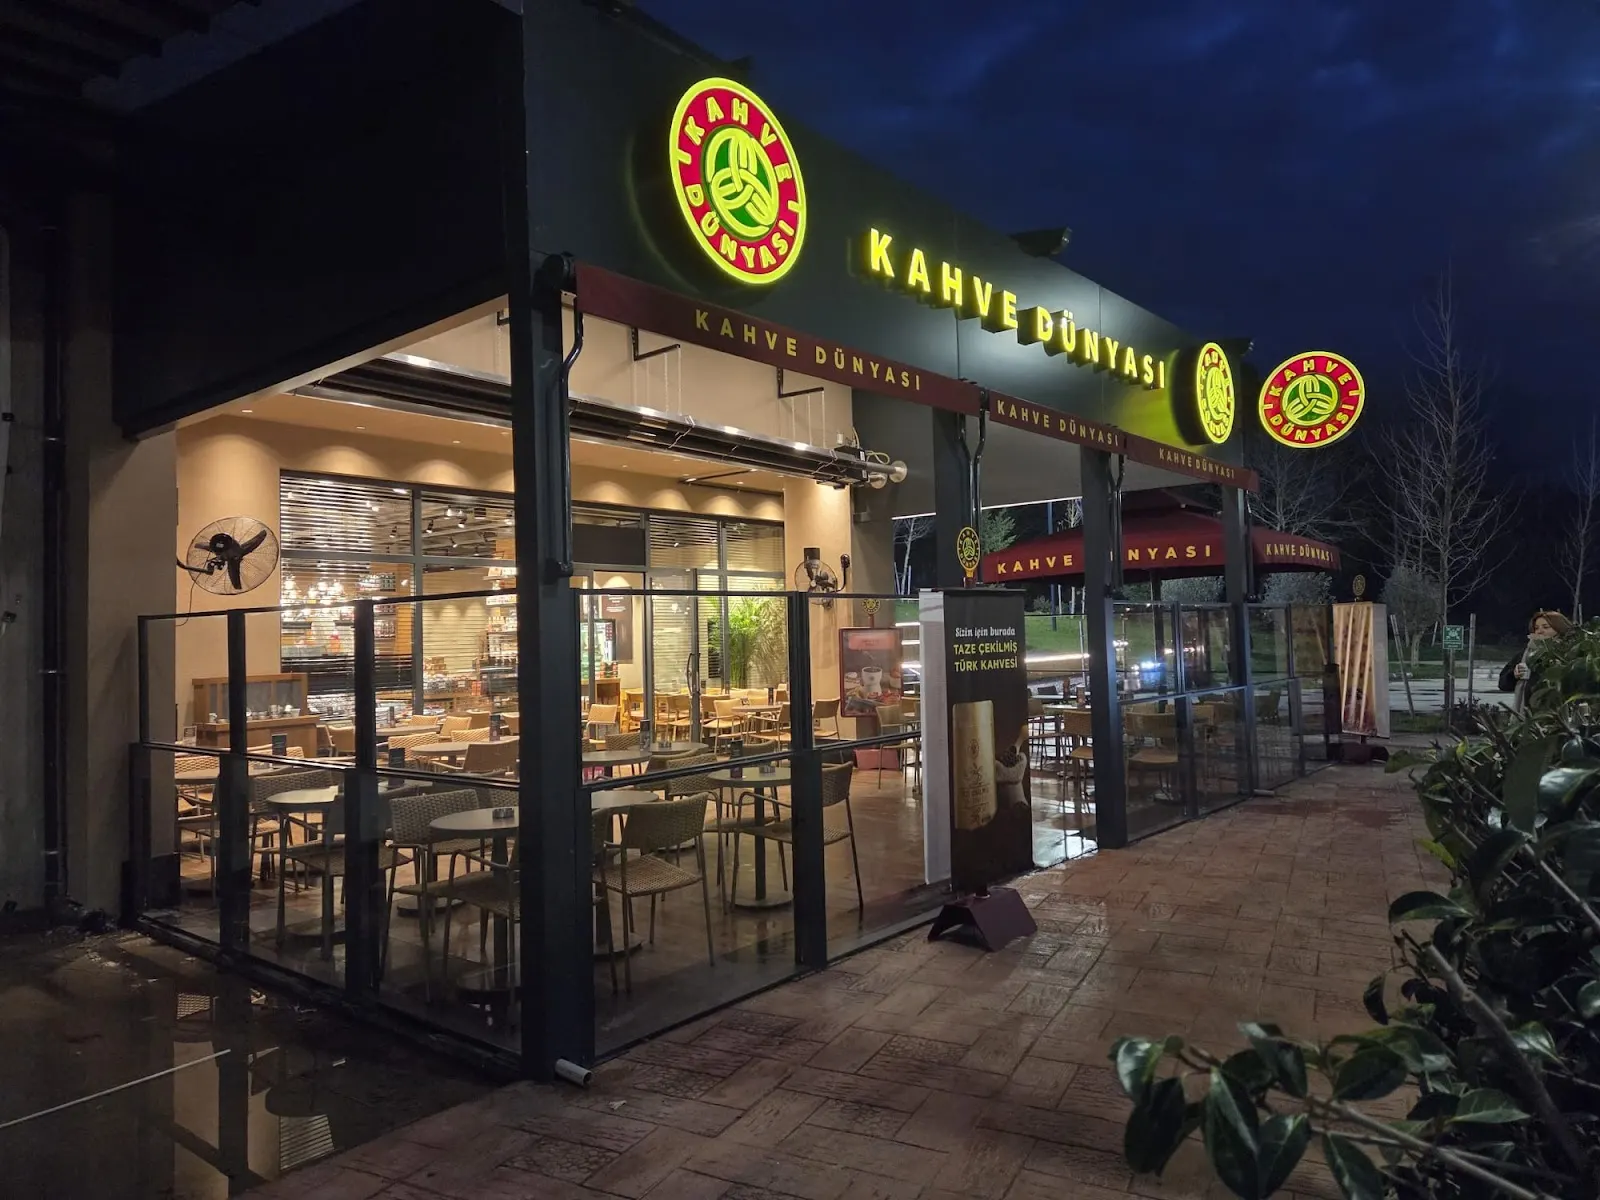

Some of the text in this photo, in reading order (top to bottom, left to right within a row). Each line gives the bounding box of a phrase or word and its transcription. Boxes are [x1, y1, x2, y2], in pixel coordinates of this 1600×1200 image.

[684, 96, 793, 183] KAHVE
[684, 184, 794, 269] DÜNYASI
[870, 227, 1165, 389] KAHVE DÜNYASI
[695, 309, 921, 391] KAHVE DÜNYASI
[1268, 359, 1352, 397] KAHVE
[997, 399, 1119, 447] KAHVE DÜNYASI
[1269, 405, 1355, 441] DÜNYASI
[1159, 447, 1235, 479] KAHVE DÜNYASI
[997, 545, 1211, 574] KAHVE NYASI
[1266, 543, 1334, 562] KAHVE DÜNYASI
[953, 640, 1018, 656] TAZE ÇEKİLMİŞ
[955, 626, 1016, 639] Sizin için burada
[954, 655, 1018, 672] TÜRK KAHVESİ
